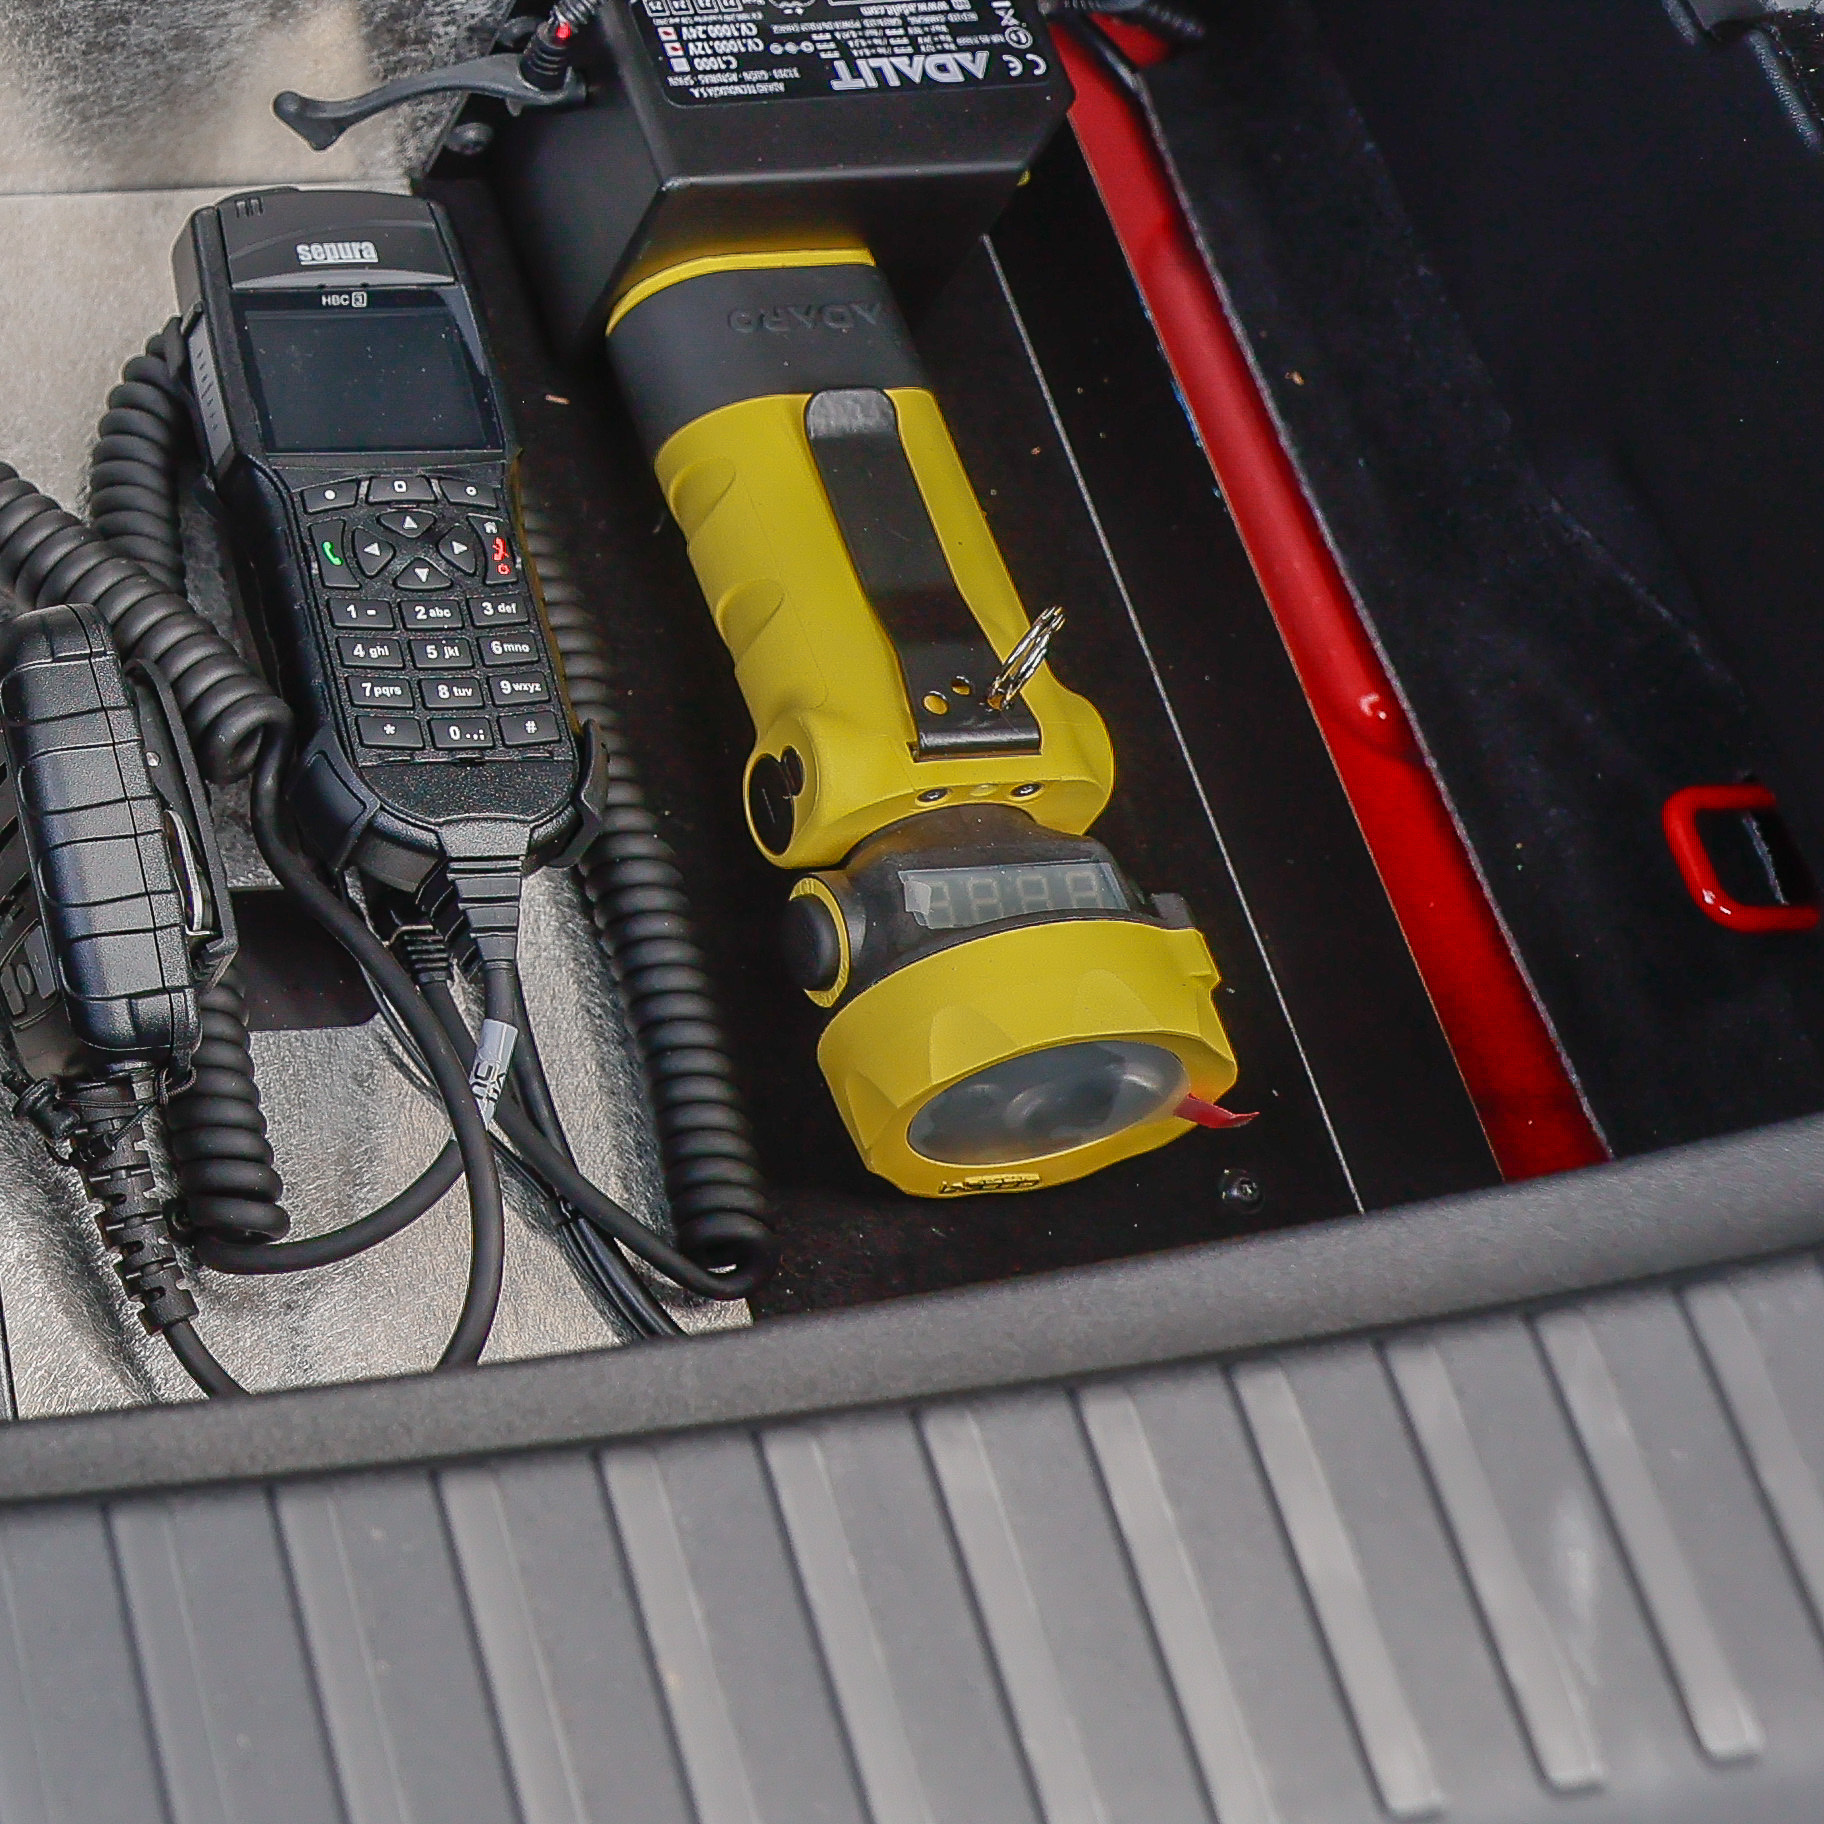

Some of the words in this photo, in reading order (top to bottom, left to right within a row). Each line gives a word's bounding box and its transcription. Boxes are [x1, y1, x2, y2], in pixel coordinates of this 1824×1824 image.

[681, 22, 758, 40] CV.1000.24V
[688, 38, 765, 56] CV.1000.12V
[693, 55, 738, 71] C.1000
[830, 51, 990, 90] ADALIT
[296, 241, 378, 265] sepura
[321, 294, 350, 306] HBC
